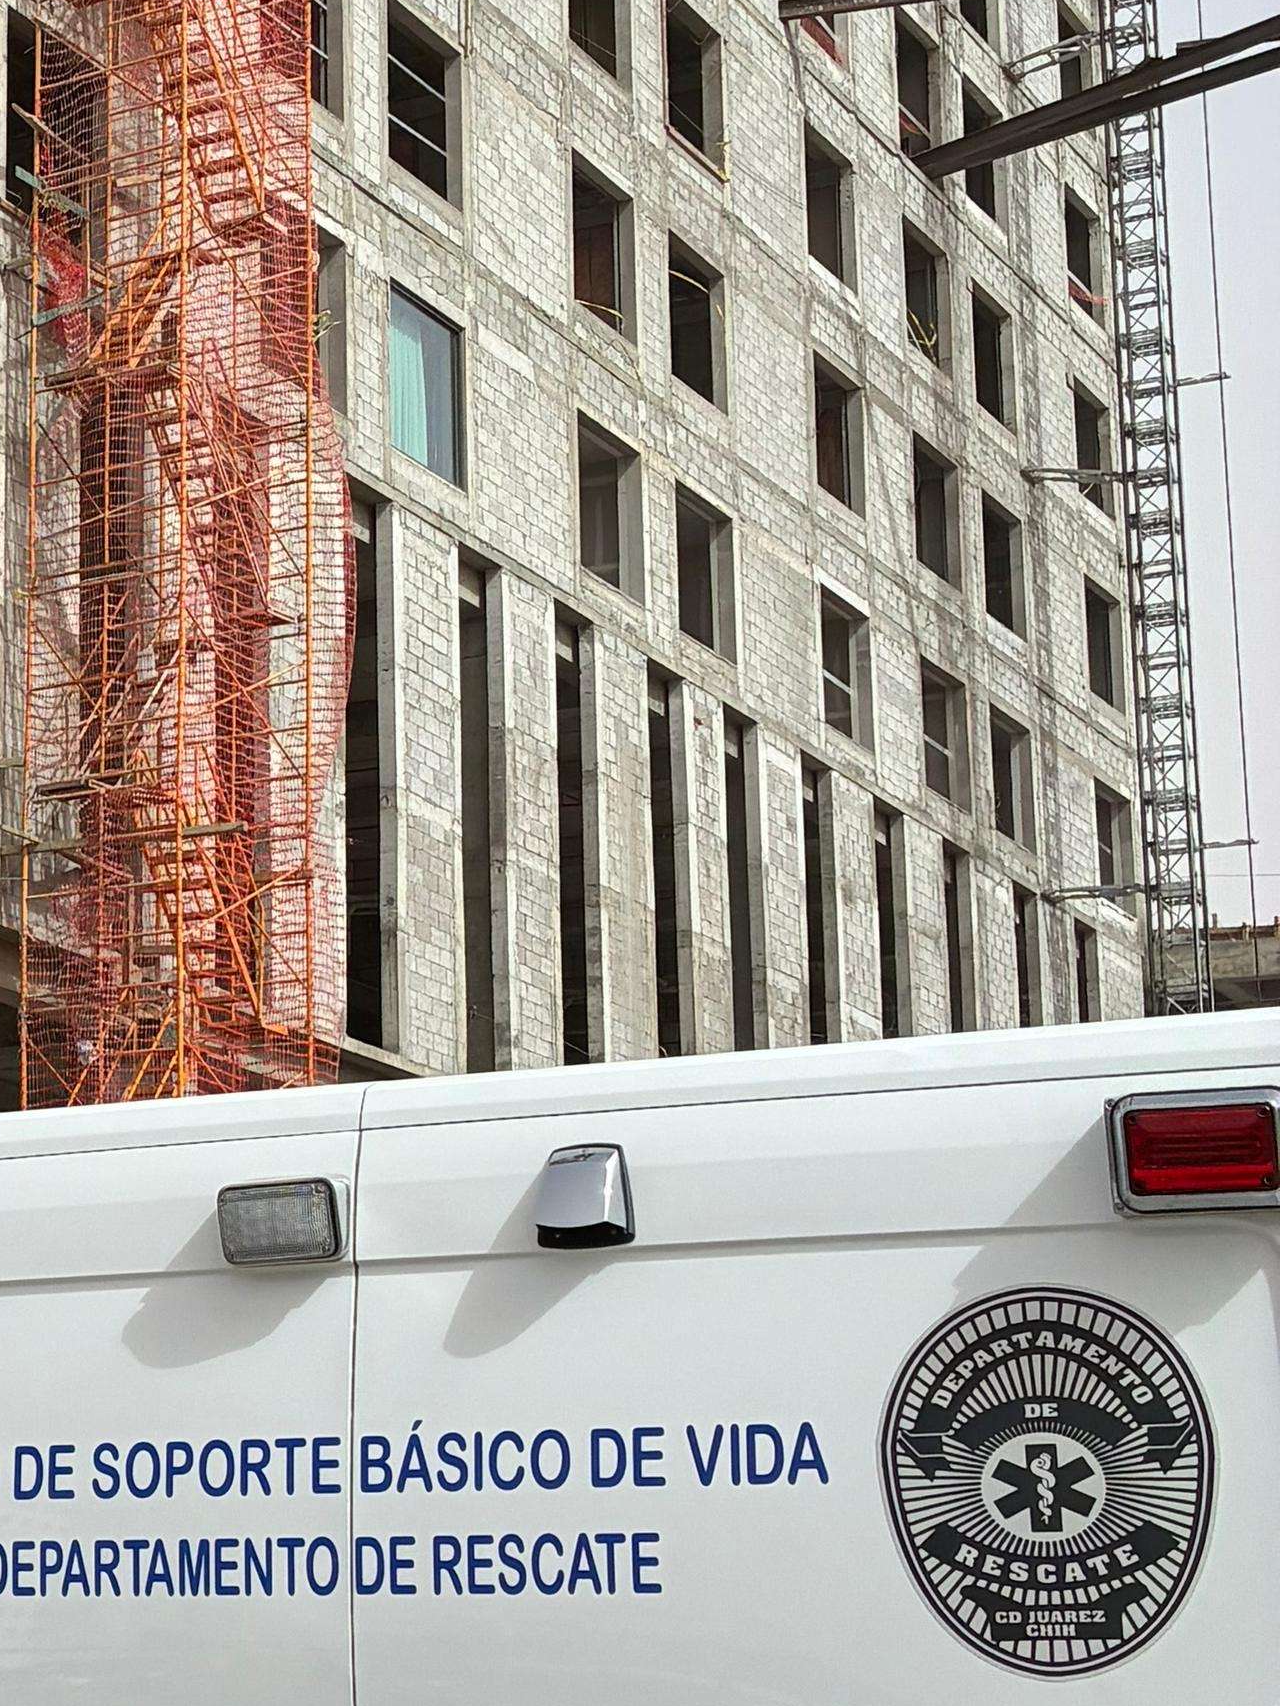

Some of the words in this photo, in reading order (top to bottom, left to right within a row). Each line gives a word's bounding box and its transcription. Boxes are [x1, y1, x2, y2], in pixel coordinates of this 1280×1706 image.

[930, 1330, 1154, 1409] DEPARTAMENTO
[1024, 1402, 1059, 1419] DE
[11, 1443, 75, 1502] DE
[90, 1435, 342, 1502] SOPORTE
[358, 1419, 572, 1496] BÁSICO
[588, 1426, 665, 1490] DE
[686, 1422, 830, 1488] VIDA
[353, 1534, 416, 1597] DE
[431, 1532, 663, 1597] RESCATE
[954, 1543, 1140, 1584] RESCATE
[995, 1611, 1022, 1624] CD
[1028, 1609, 1107, 1624] JUAREZ
[1025, 1624, 1077, 1637] CHIH
